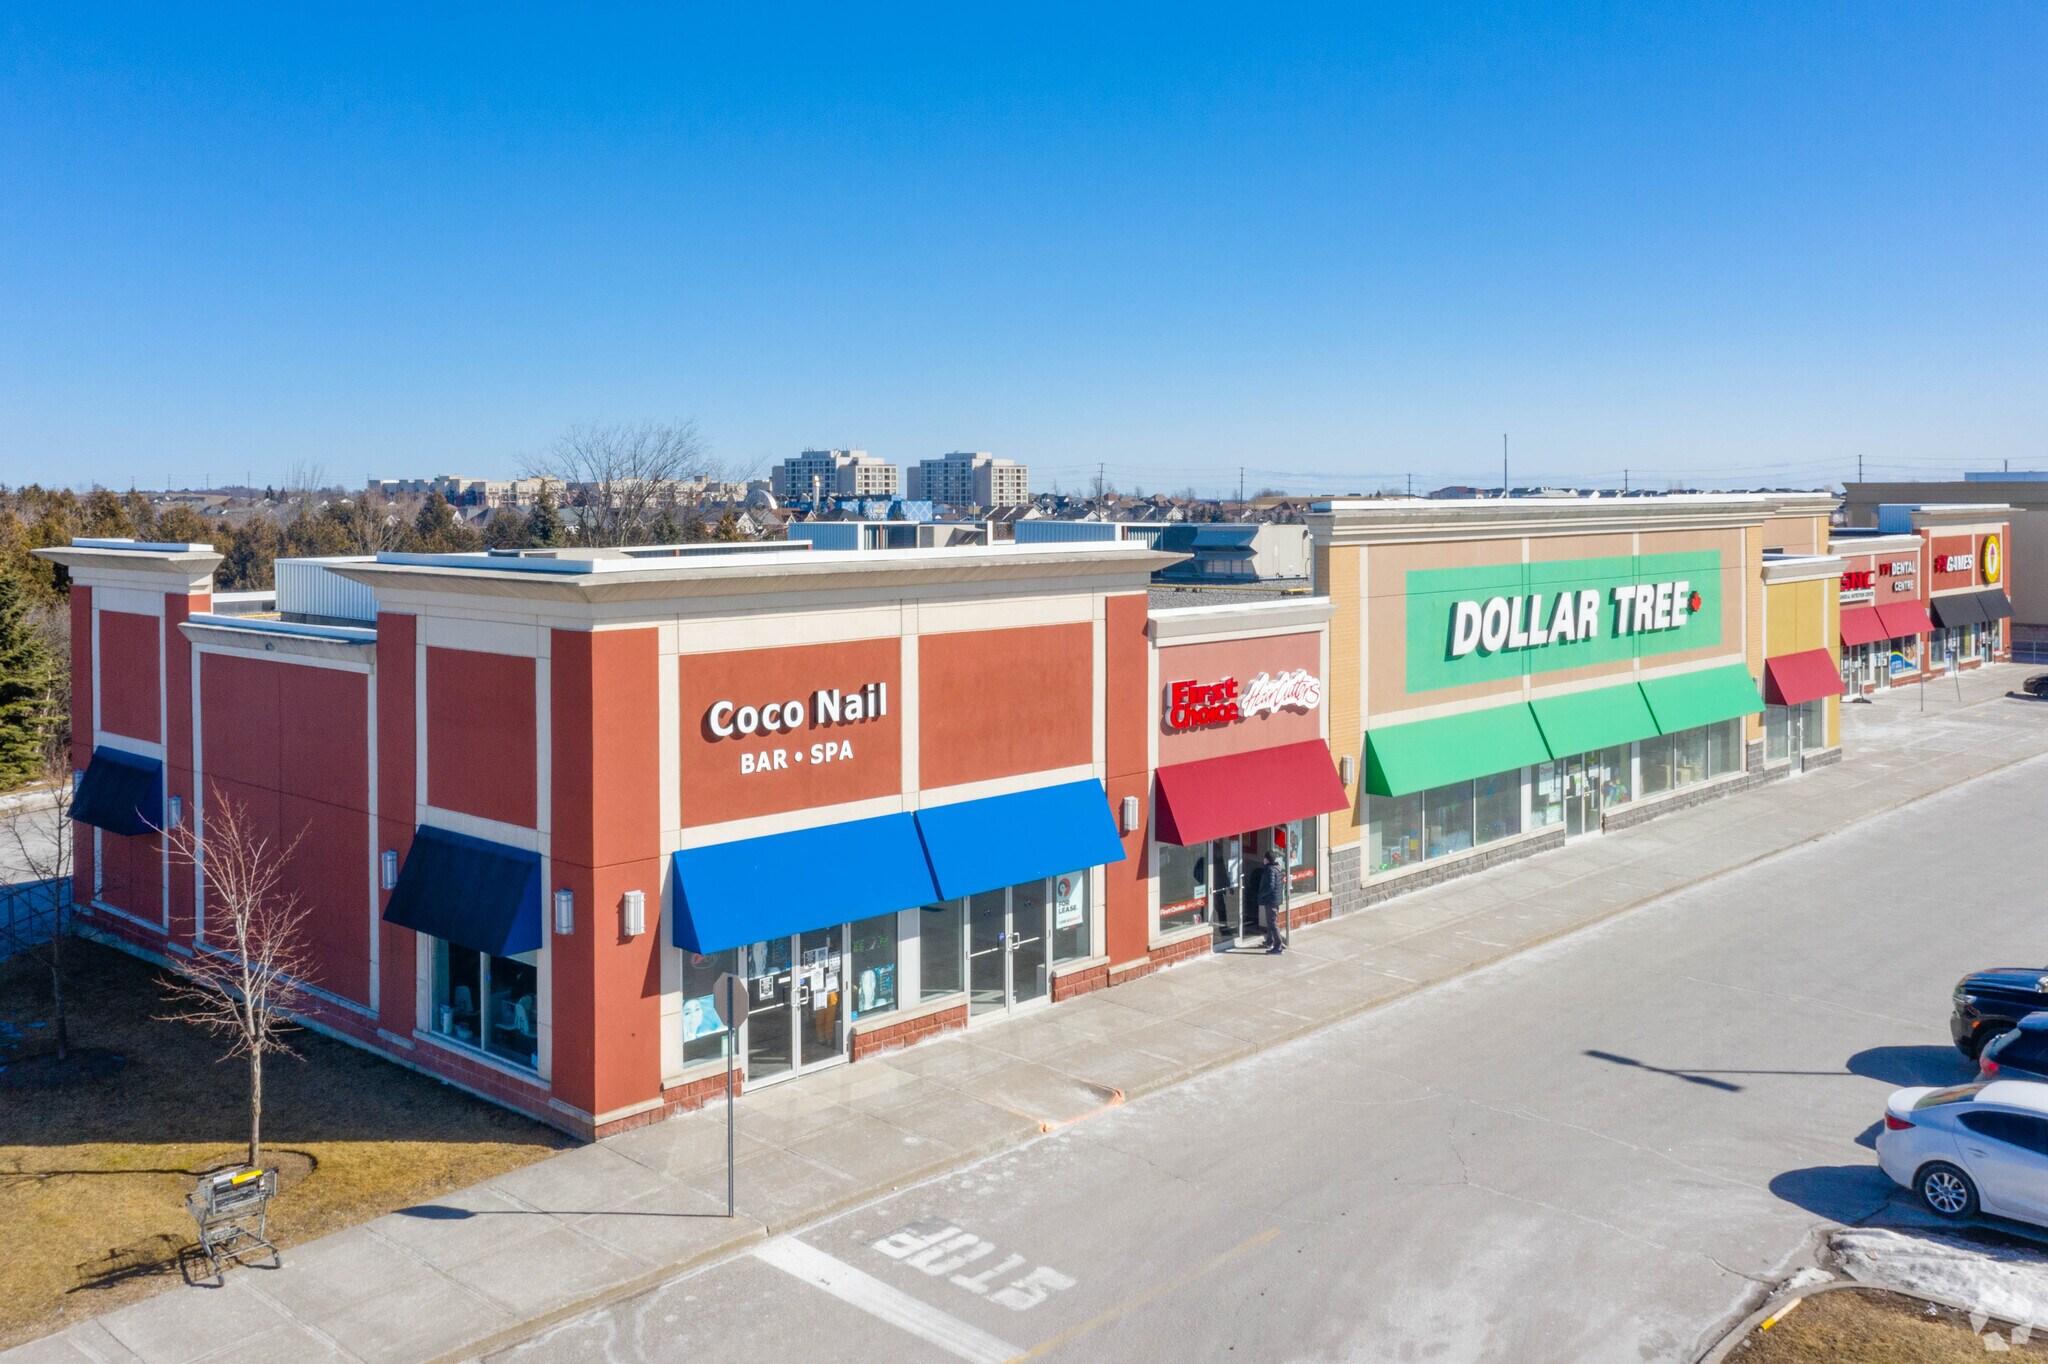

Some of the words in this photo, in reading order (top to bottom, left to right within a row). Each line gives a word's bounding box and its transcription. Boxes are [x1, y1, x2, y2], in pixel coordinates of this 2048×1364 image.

[1891, 561, 1916, 576] DENTAL
[1947, 554, 1973, 572] GAMES
[1894, 580, 1914, 592] CENTRE
[1451, 589, 1601, 656] DOLLAR
[1614, 580, 1690, 634] TREE
[1170, 677, 1239, 707] First
[709, 700, 805, 737] Coco
[817, 682, 887, 724] Nail
[1169, 703, 1239, 729] Choice
[741, 748, 789, 775] BAR
[810, 740, 854, 765] SPA
[1058, 899, 1070, 908] FOR
[1058, 904, 1077, 915] LEASE
[870, 1226, 1078, 1311] STOP
